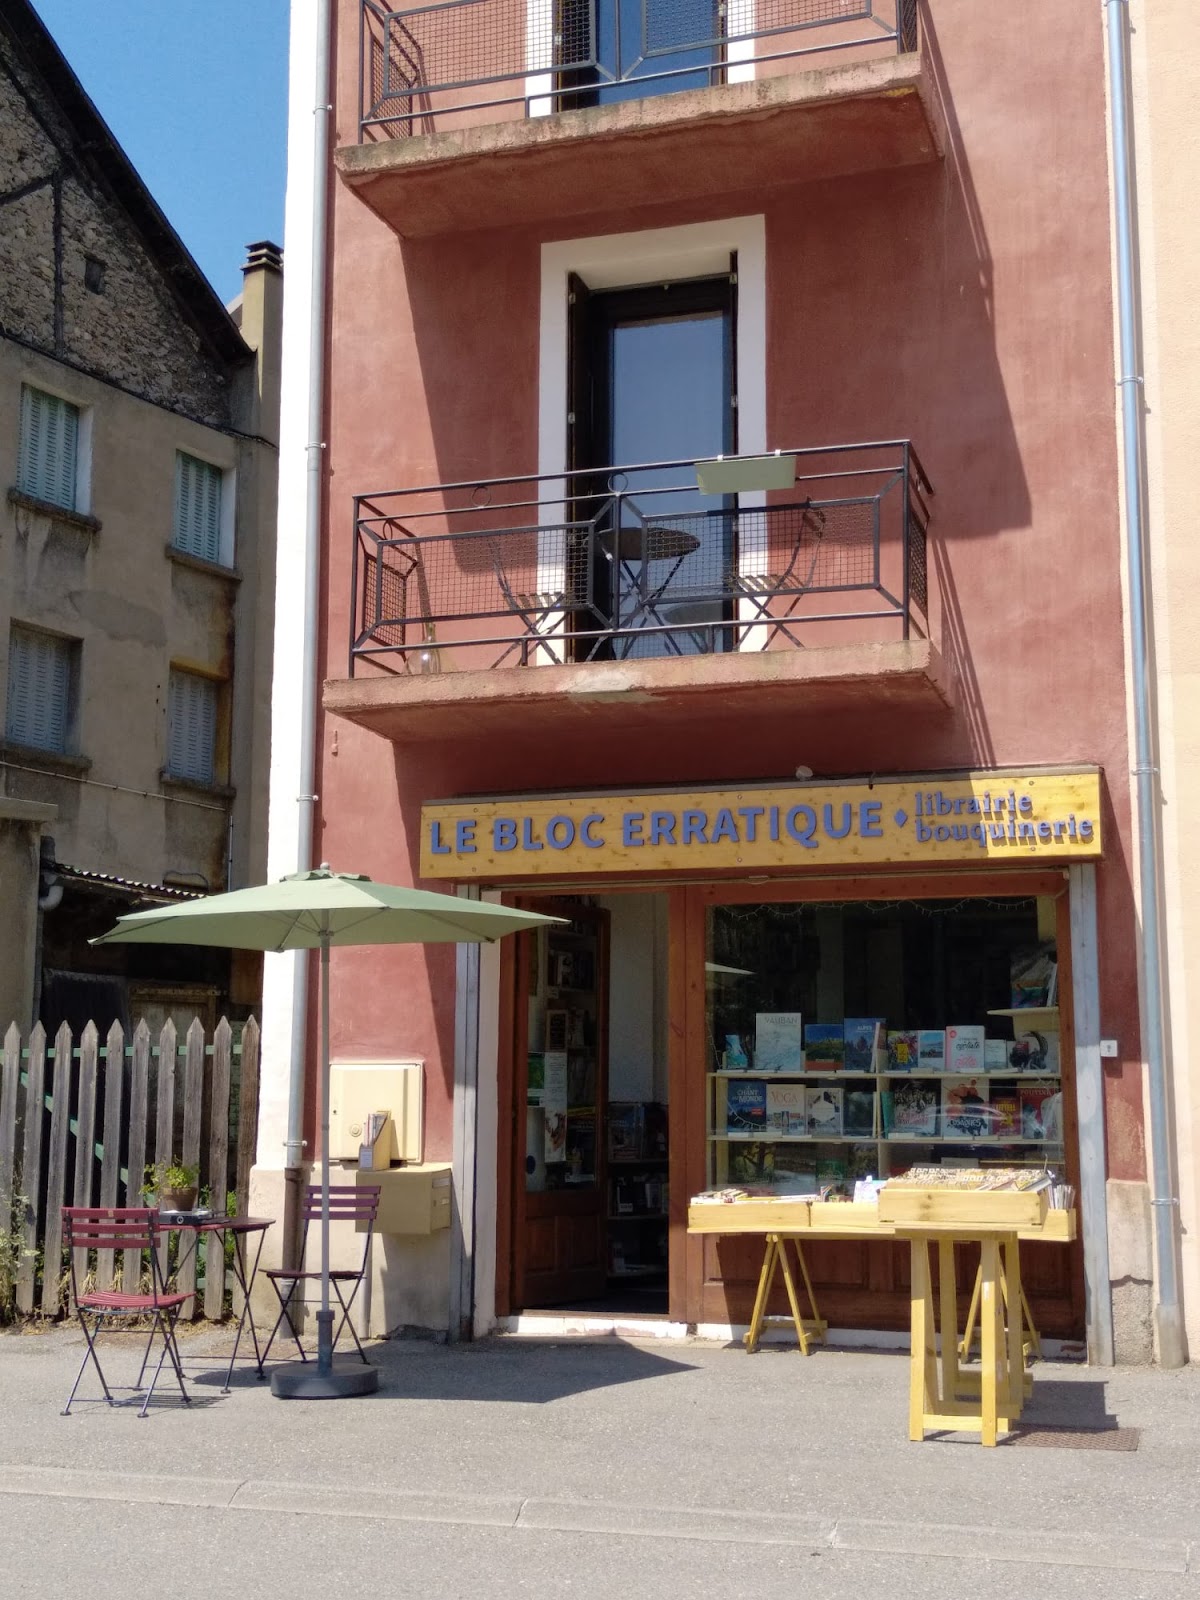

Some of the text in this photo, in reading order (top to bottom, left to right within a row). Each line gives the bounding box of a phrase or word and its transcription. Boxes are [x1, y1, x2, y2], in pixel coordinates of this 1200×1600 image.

[915, 789, 1033, 816] librairie
[431, 802, 883, 854] LE BLOC ERRATIQUE
[915, 814, 1094, 848] bouquinerie
[764, 1016, 798, 1025] VAUBAN
[739, 1095, 763, 1103] MONDE
[771, 1090, 798, 1103] YOGA
